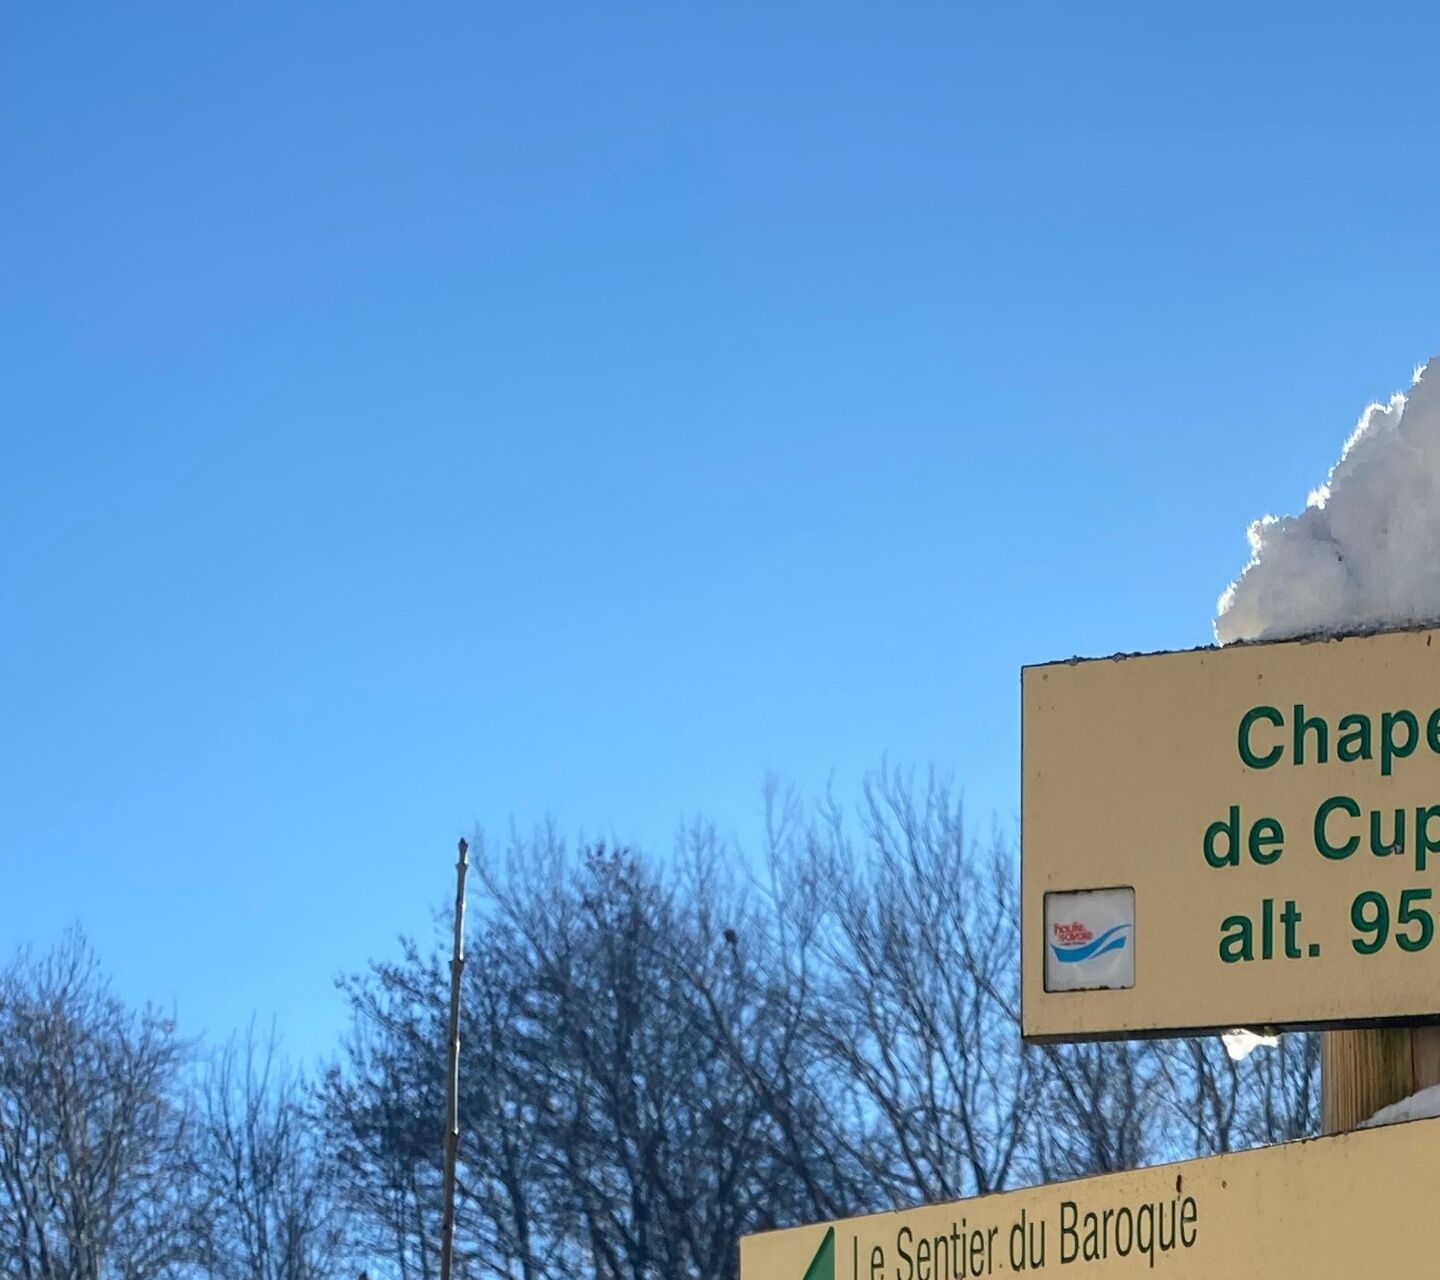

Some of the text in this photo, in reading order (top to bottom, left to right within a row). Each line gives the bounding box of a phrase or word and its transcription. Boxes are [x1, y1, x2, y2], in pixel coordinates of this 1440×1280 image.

[1203, 806, 1284, 868] de
[1219, 899, 1320, 963] alt.
[1010, 1209, 1045, 1272] du
[1061, 1197, 1197, 1268] Baroque
